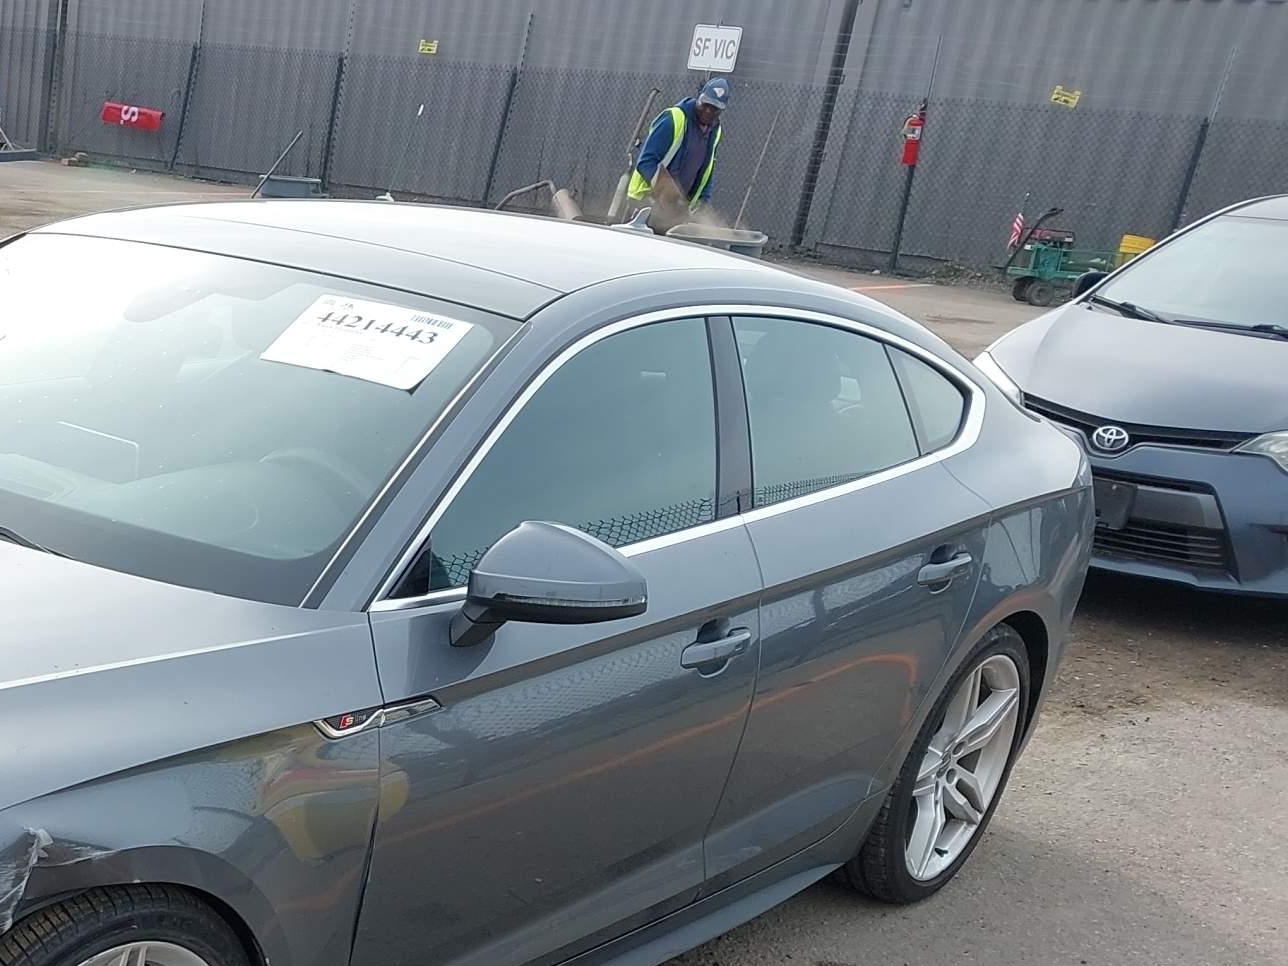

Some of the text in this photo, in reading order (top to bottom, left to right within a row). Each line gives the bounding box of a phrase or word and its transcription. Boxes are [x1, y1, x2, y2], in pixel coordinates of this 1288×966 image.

[693, 37, 736, 60] SF VIC
[316, 311, 439, 345] 44214443
